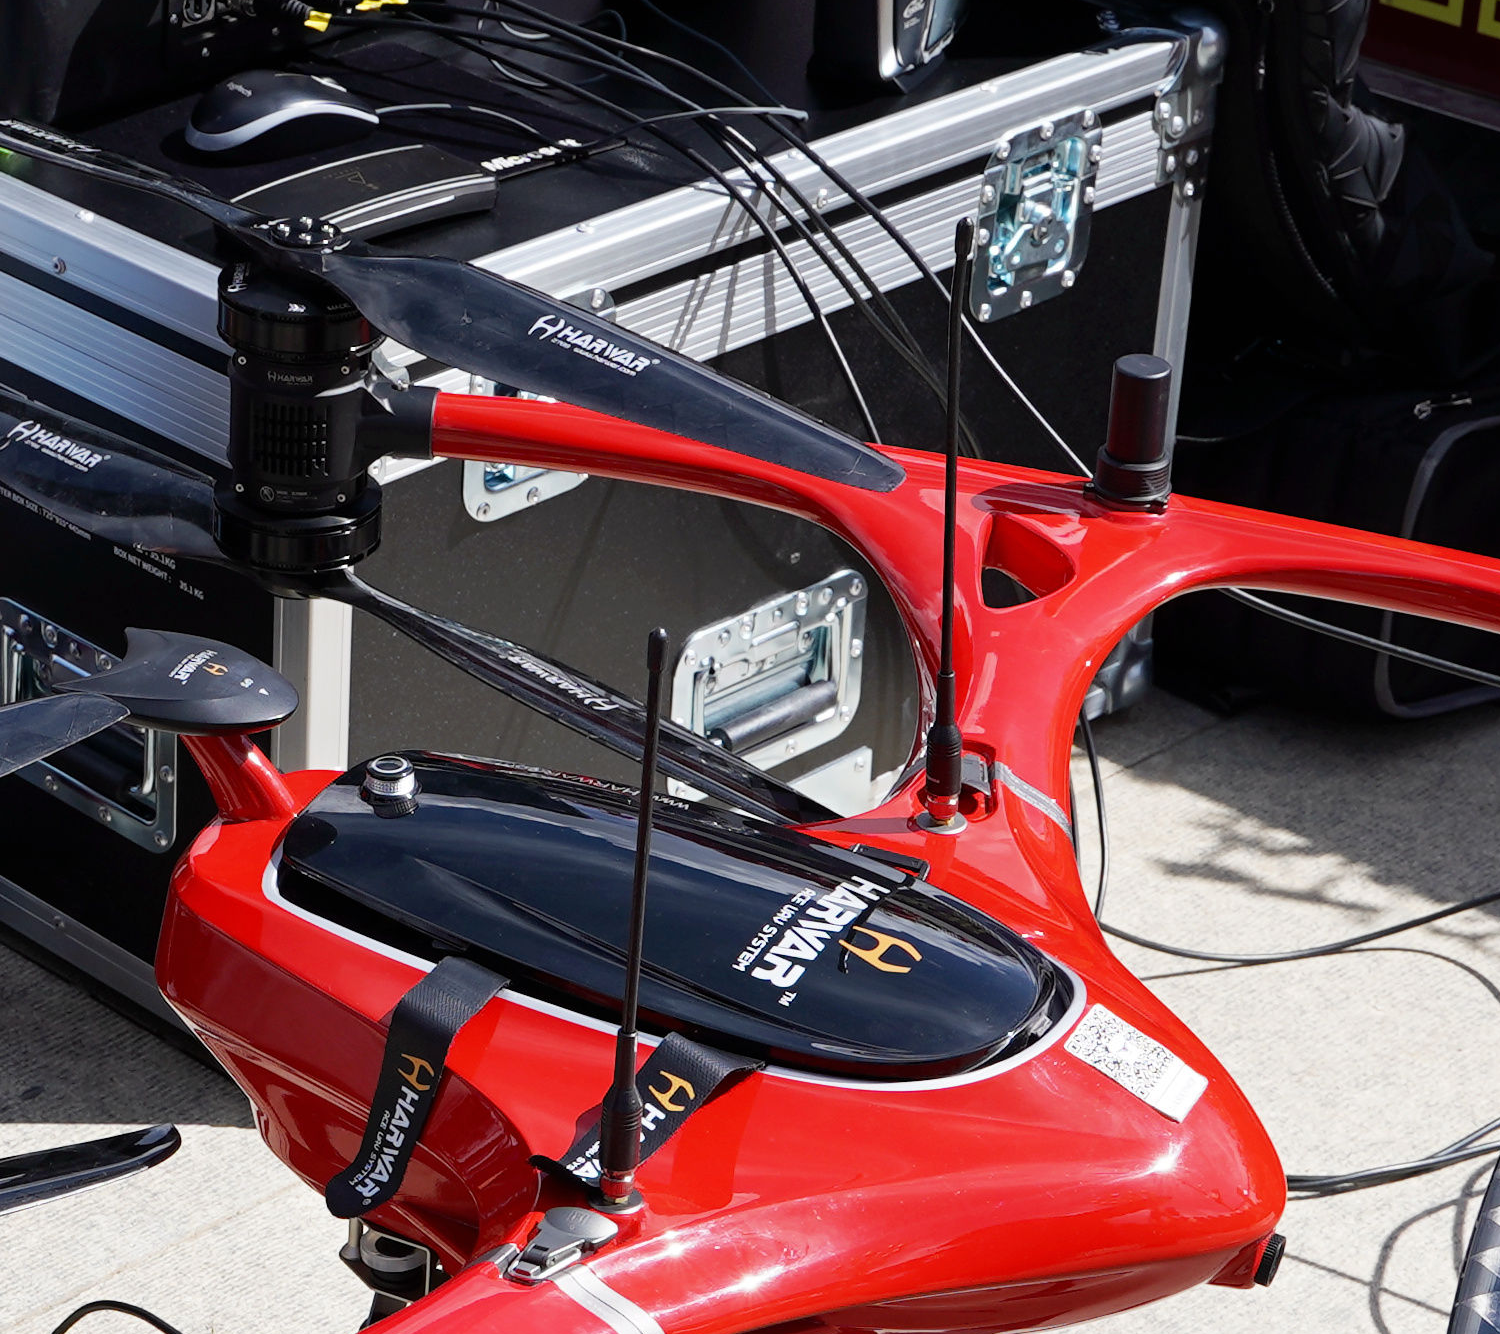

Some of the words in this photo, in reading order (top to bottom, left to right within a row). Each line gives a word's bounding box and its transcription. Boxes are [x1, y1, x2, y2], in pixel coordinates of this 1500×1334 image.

[558, 325, 653, 373] HARWAR
[32, 428, 103, 468] HARWAR
[773, 904, 799, 926] UAV
[790, 887, 818, 906] ACE
[732, 924, 779, 972] SYSTEM
[751, 875, 891, 988] HARWAR
[355, 1085, 420, 1198] HARWAR
